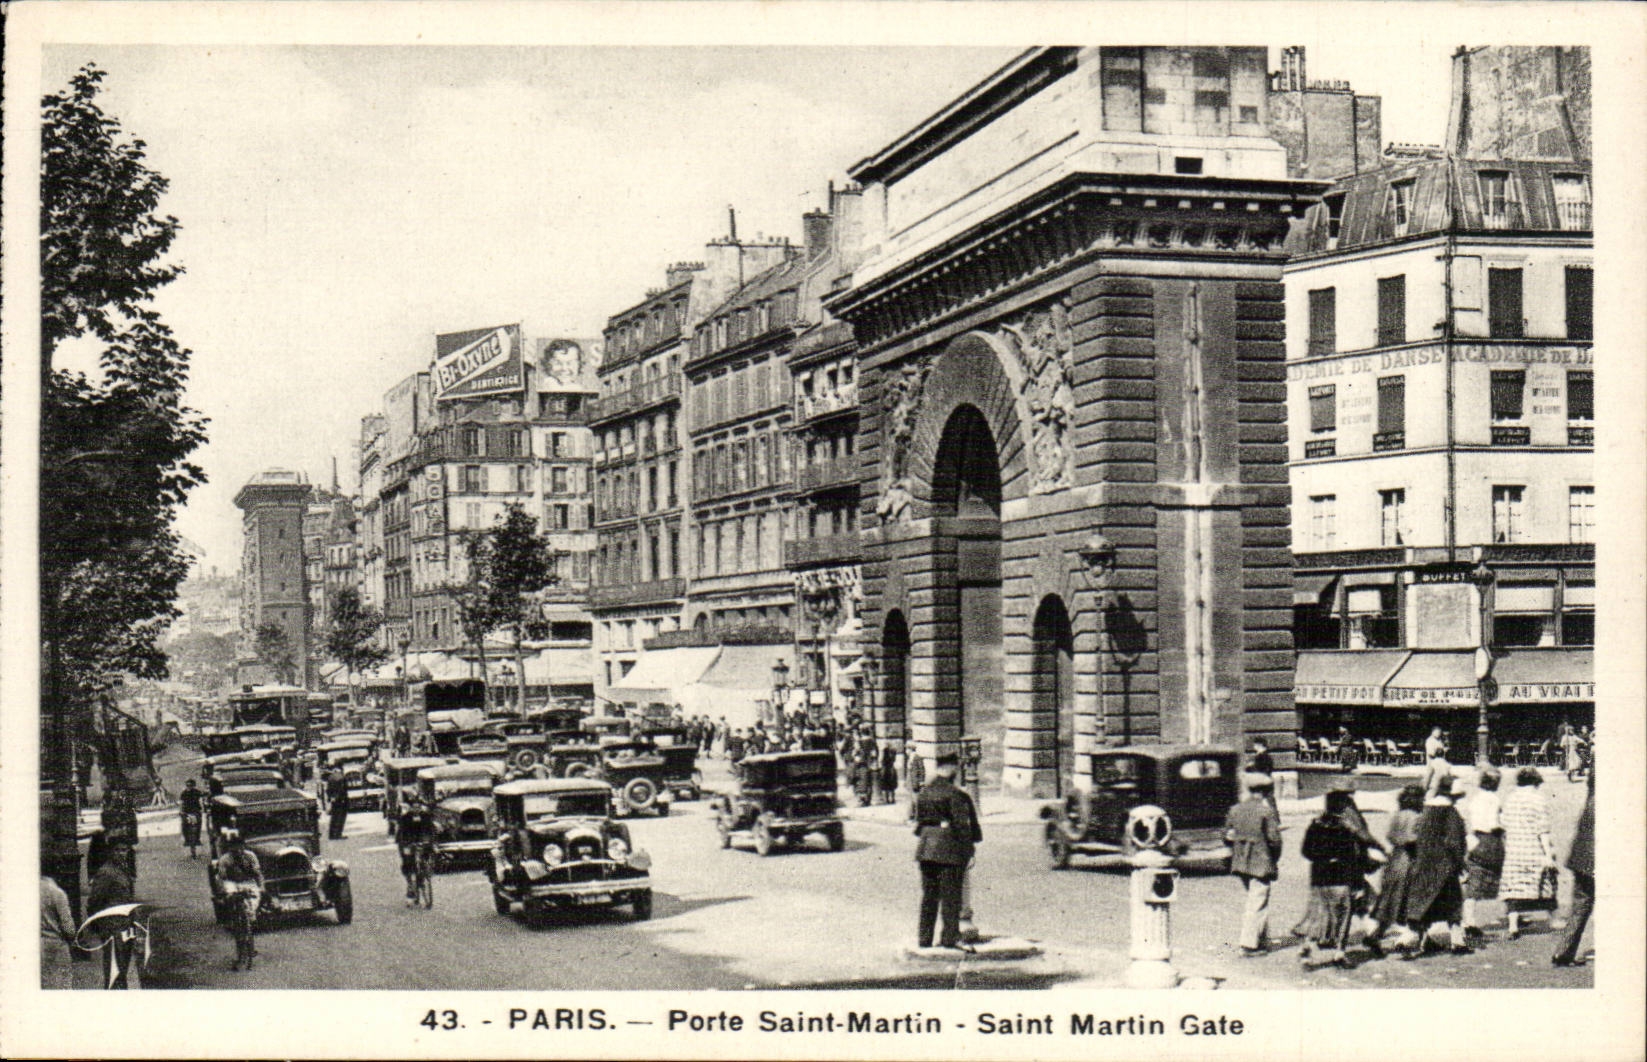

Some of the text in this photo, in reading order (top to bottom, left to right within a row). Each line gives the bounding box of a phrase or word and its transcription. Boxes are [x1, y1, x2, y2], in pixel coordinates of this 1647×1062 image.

[1352, 358, 1372, 374] DE
[1381, 346, 1442, 370] DANSE
[1422, 572, 1465, 582] BUFFET
[1509, 686, 1532, 698] AU
[1538, 685, 1581, 698] VRAI
